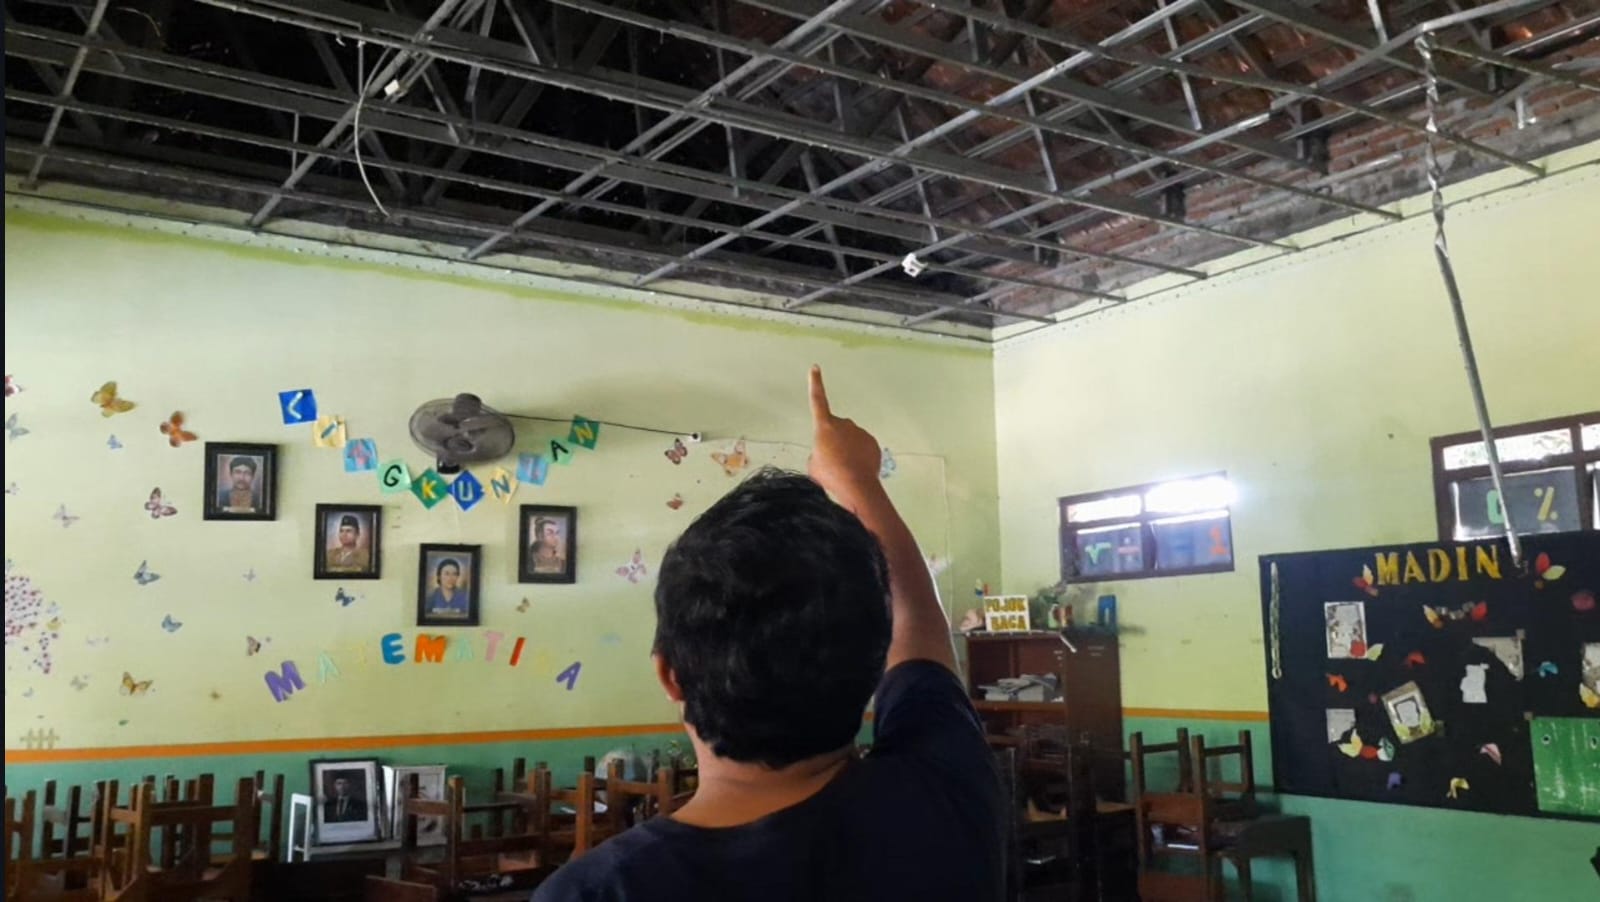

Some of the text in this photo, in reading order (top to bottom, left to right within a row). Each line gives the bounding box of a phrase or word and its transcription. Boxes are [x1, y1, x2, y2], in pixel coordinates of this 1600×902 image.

[1374, 545, 1503, 587] MADIN
[985, 597, 1026, 613] POJOK
[990, 615, 1027, 631] BACA
